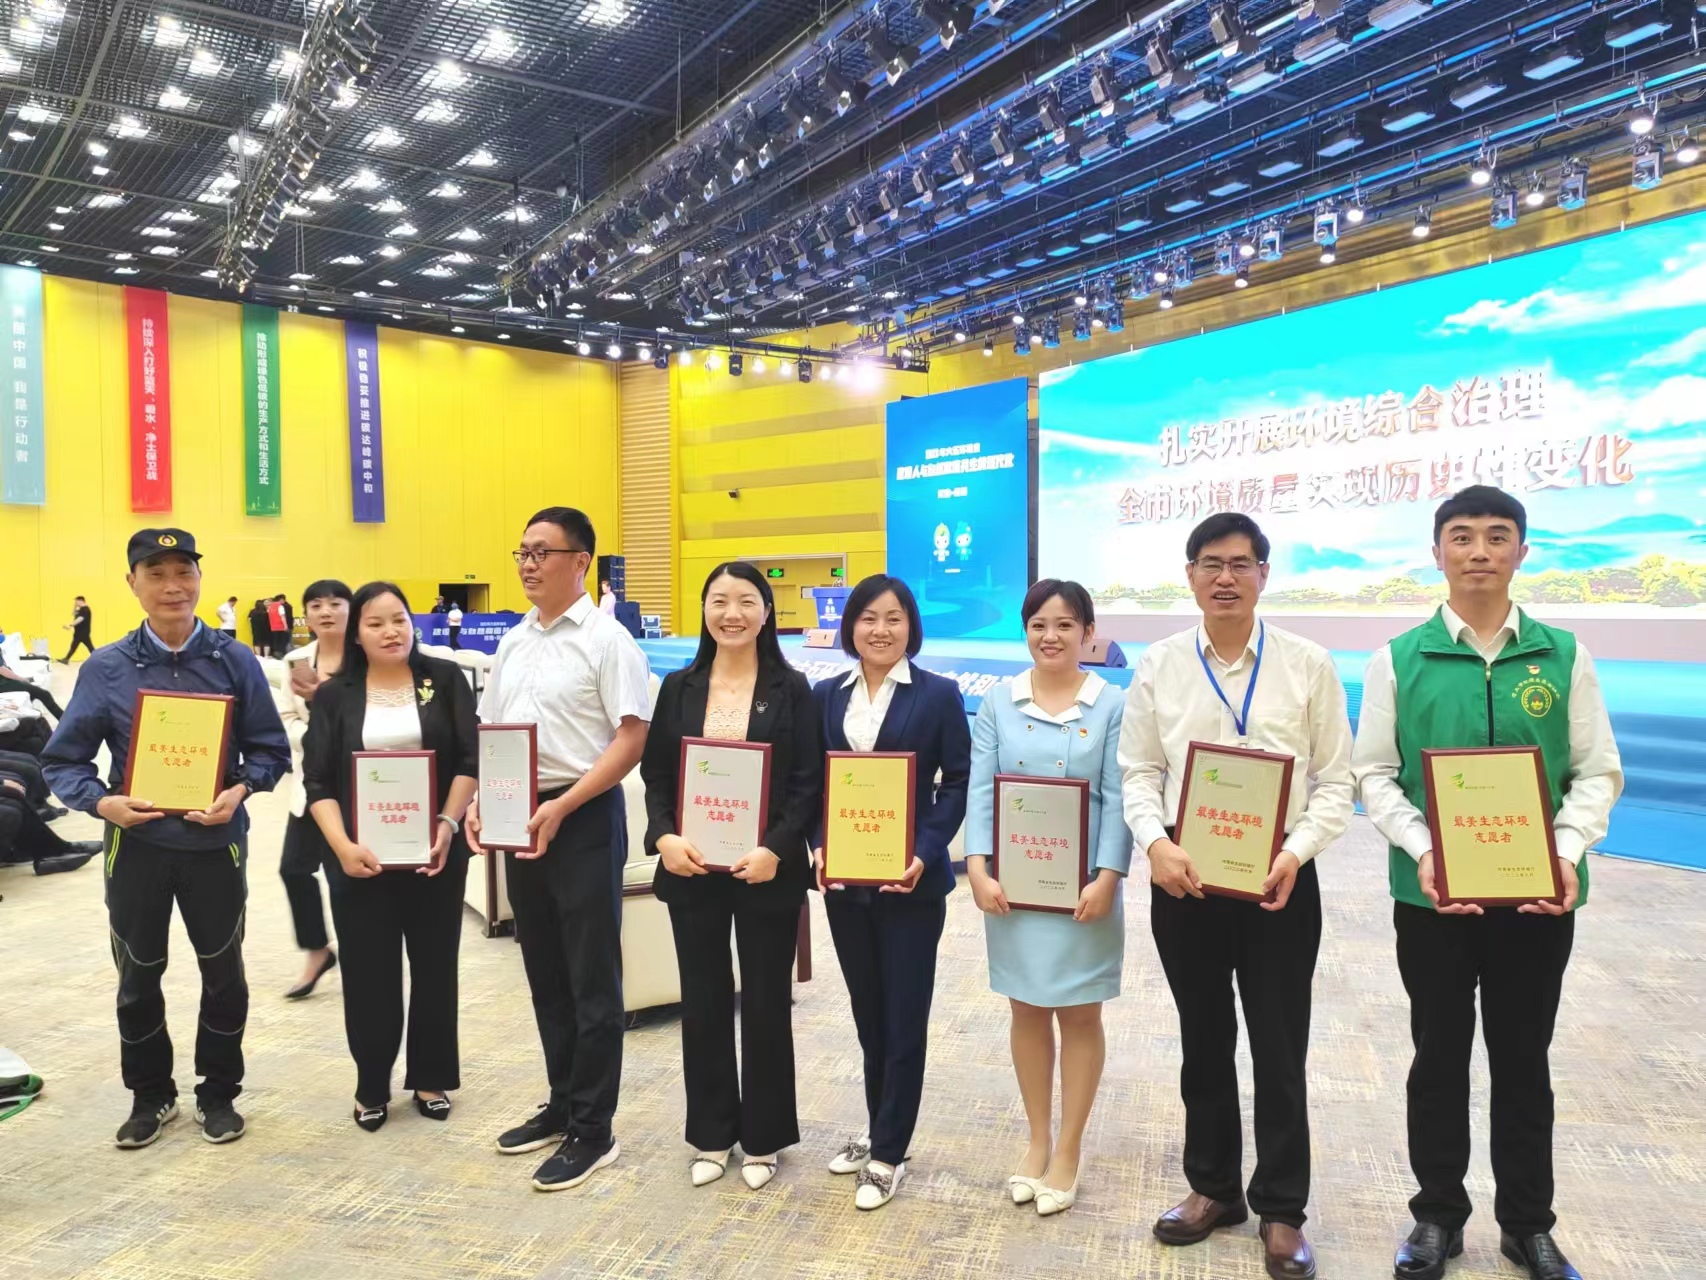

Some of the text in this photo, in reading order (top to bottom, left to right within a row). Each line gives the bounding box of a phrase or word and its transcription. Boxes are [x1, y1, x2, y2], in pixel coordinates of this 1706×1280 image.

[14, 379, 29, 463] 我是行动者
[357, 347, 373, 494] 积极稳妥推进碳达峰碳中和
[1159, 368, 1547, 467] 扎实开展环境综合治理
[1118, 433, 1636, 525] 全市环境质量实现历史性变化
[148, 743, 209, 757] 最美生态环境
[162, 757, 192, 767] 志愿者
[693, 795, 750, 811] 最美生态环境
[706, 811, 736, 823] 志愿者
[839, 808, 897, 820] 最美生态环境
[1195, 805, 1264, 828] 最美生态环境
[1453, 815, 1530, 828] 最美生态环境
[852, 822, 882, 833] 志愿者
[1208, 824, 1245, 841] 志愿者
[1009, 833, 1070, 849] 最美生态环境
[1474, 831, 1513, 844] 志愿者
[1024, 849, 1054, 861] 志愿者
